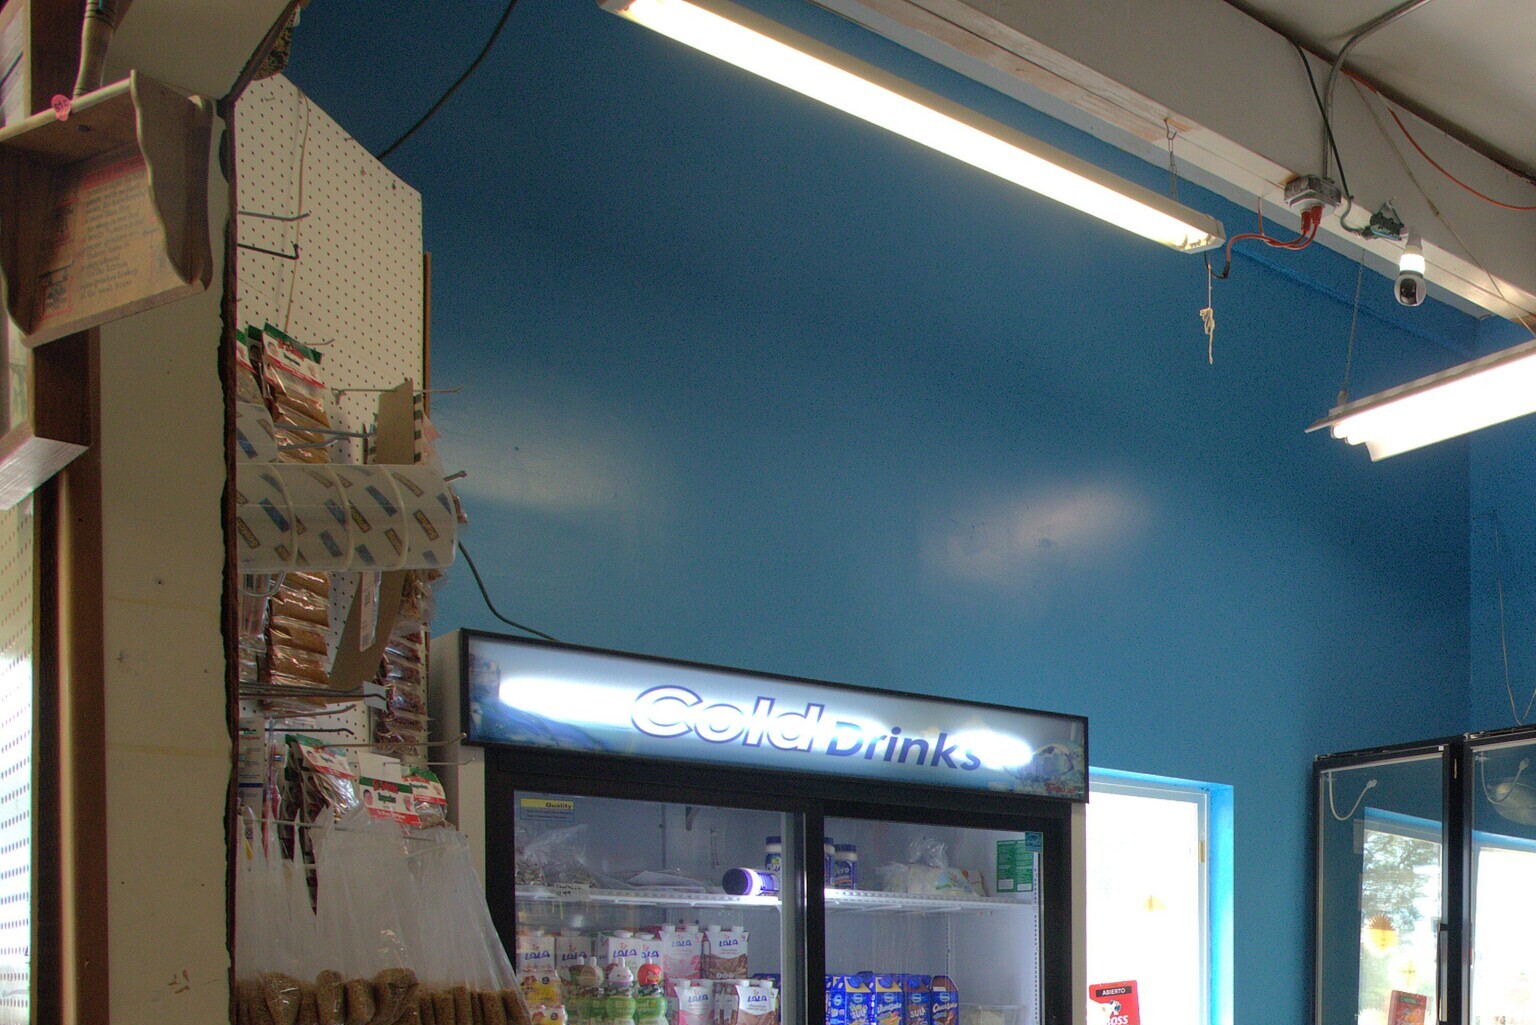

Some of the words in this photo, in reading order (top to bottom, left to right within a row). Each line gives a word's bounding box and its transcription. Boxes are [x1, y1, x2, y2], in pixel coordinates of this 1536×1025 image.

[630, 683, 826, 753] Cold
[825, 720, 982, 772] Drinks
[671, 940, 692, 948] LALA
[719, 939, 739, 947] LALA
[525, 950, 551, 960] LALA
[613, 948, 638, 958] LALA
[1102, 988, 1126, 996] ABIERTO
[688, 994, 708, 1003] LALA
[748, 994, 768, 1003] LALA
